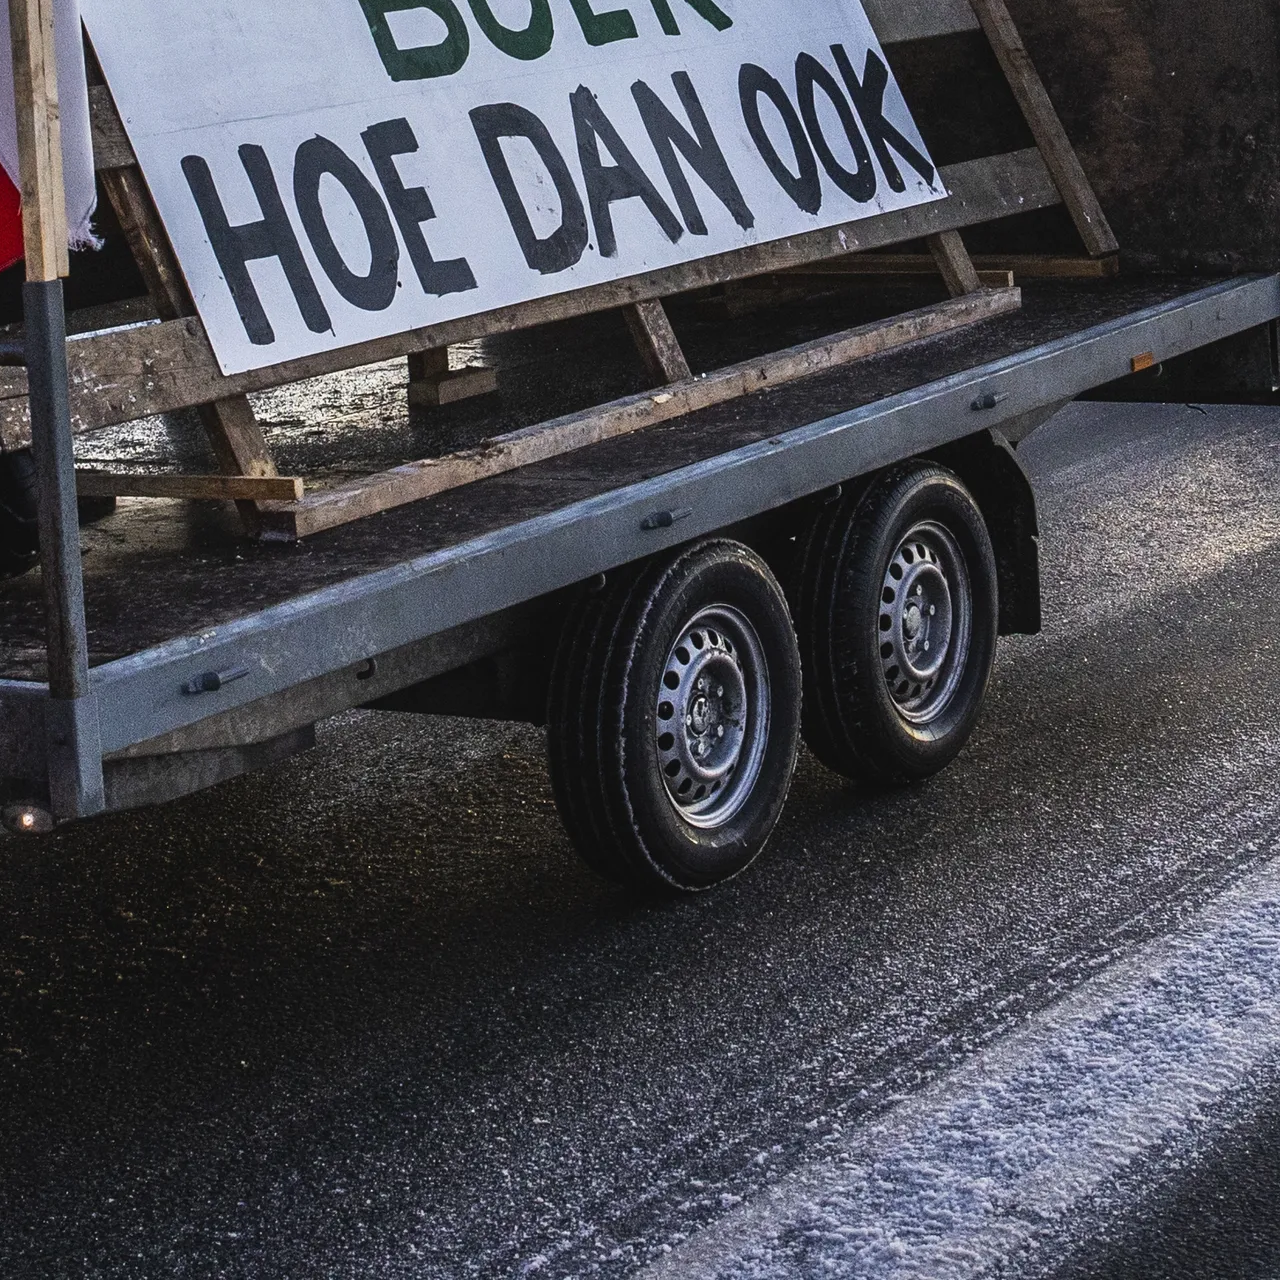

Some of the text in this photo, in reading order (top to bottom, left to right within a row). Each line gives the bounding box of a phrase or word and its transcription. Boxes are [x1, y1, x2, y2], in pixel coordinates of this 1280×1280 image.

[181, 43, 936, 346] HOE DAN OOK
